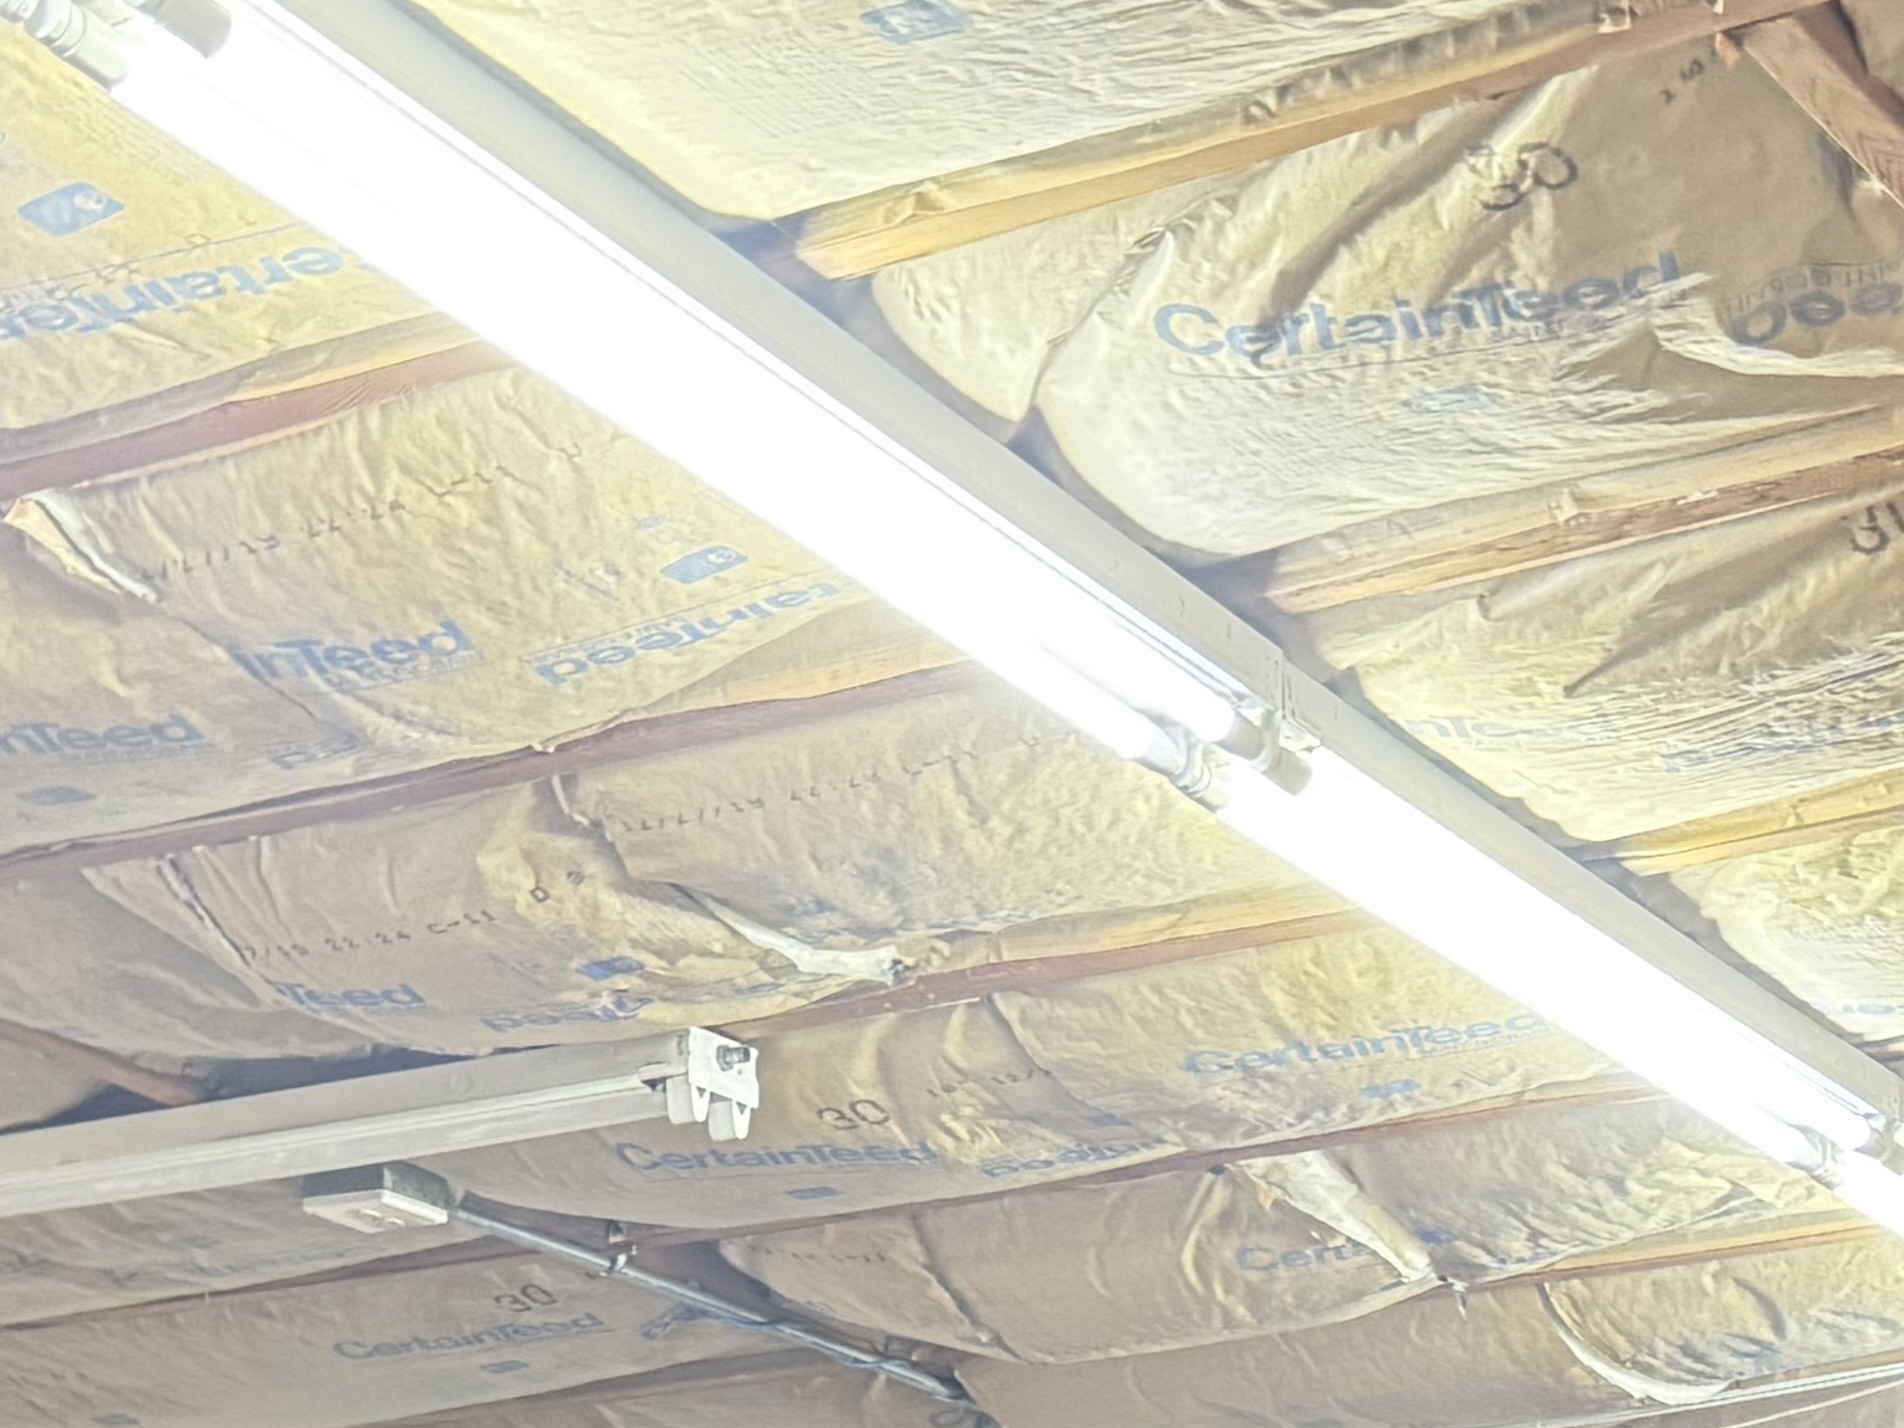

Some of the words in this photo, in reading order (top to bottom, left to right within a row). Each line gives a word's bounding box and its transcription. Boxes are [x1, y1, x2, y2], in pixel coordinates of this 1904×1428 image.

[1151, 250, 1684, 366] CertainTeed
[816, 1098, 891, 1132] 30
[615, 1140, 939, 1173] CertainTeed
[332, 1312, 605, 1360] CertainTeed
